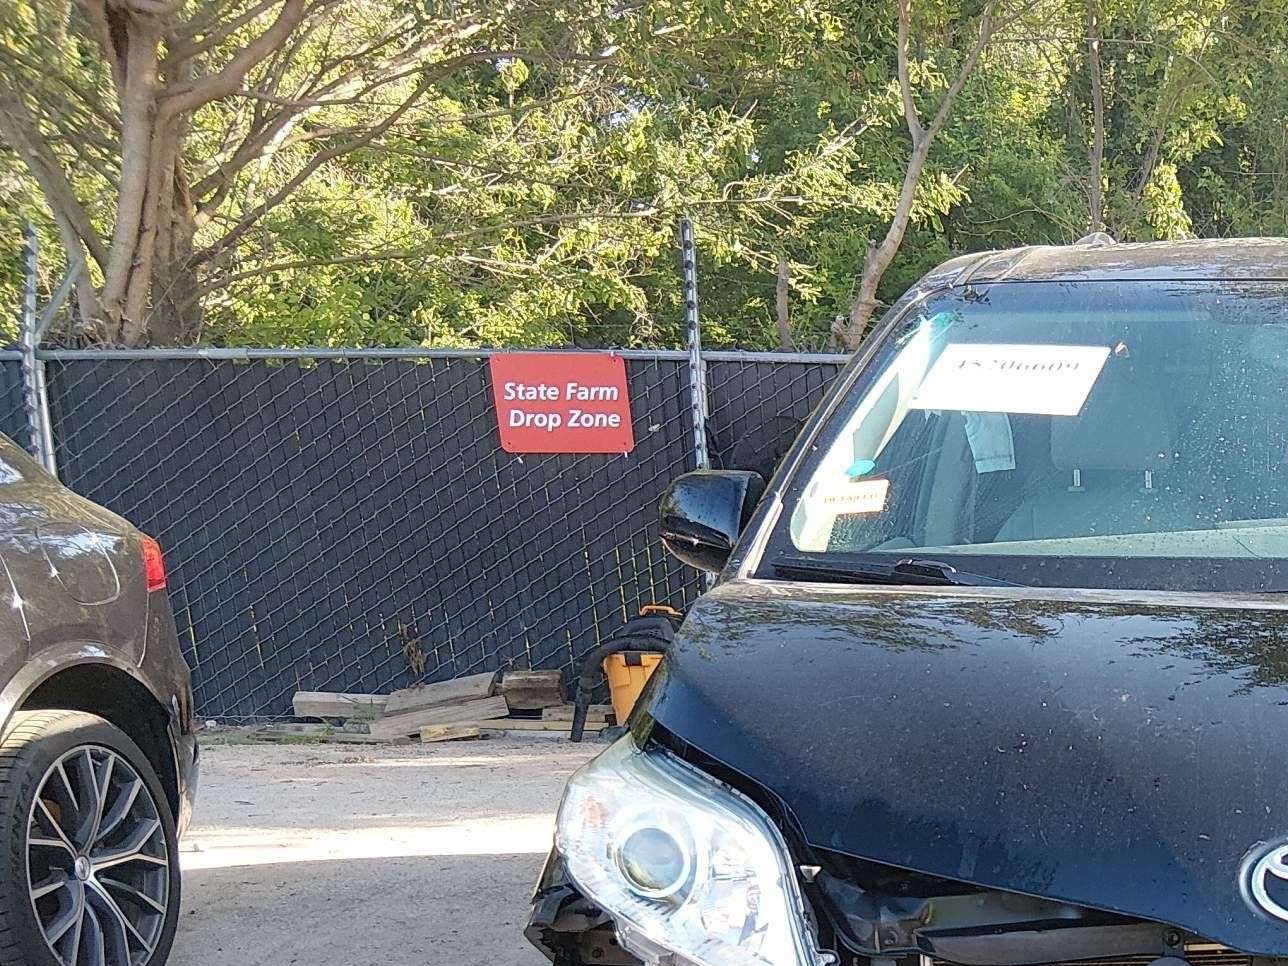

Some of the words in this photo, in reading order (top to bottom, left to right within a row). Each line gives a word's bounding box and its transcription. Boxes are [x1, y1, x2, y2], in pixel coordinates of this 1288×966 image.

[503, 382, 560, 401] State
[566, 382, 618, 401] Farm
[509, 409, 562, 432] Drop
[567, 409, 621, 427] Zone
